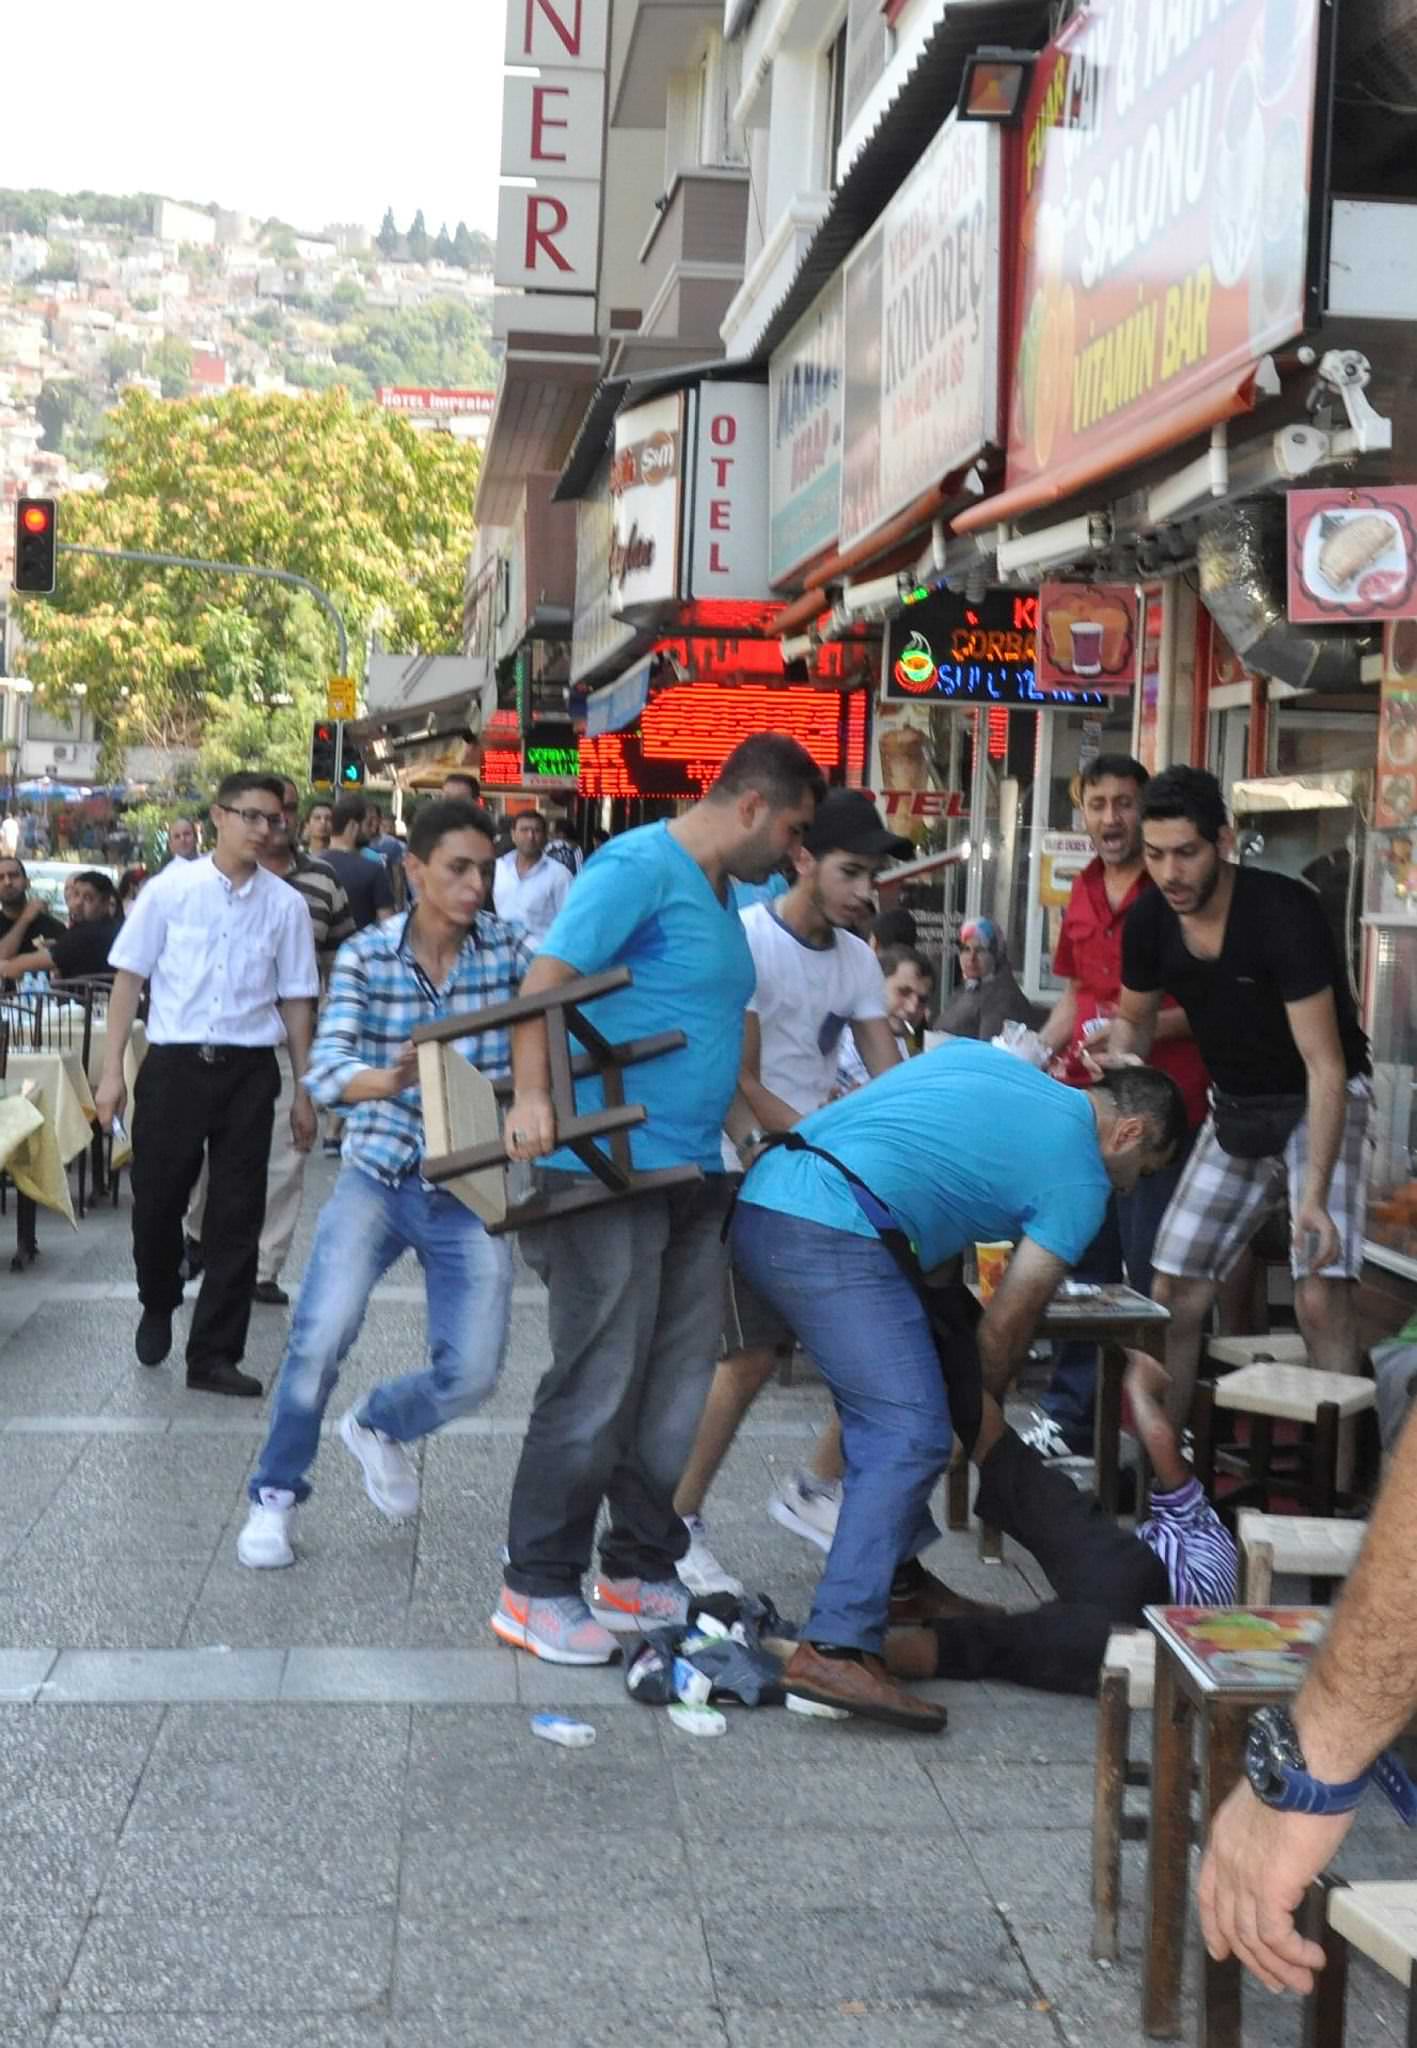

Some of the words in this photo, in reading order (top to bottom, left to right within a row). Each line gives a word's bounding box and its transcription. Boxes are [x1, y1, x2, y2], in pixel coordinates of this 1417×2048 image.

[1081, 69, 1215, 289] SALONU
[885, 200, 985, 397] KOKOREÇ
[1161, 262, 1212, 382] BAR
[709, 414, 737, 573] OTEL
[862, 787, 971, 817] TEL
